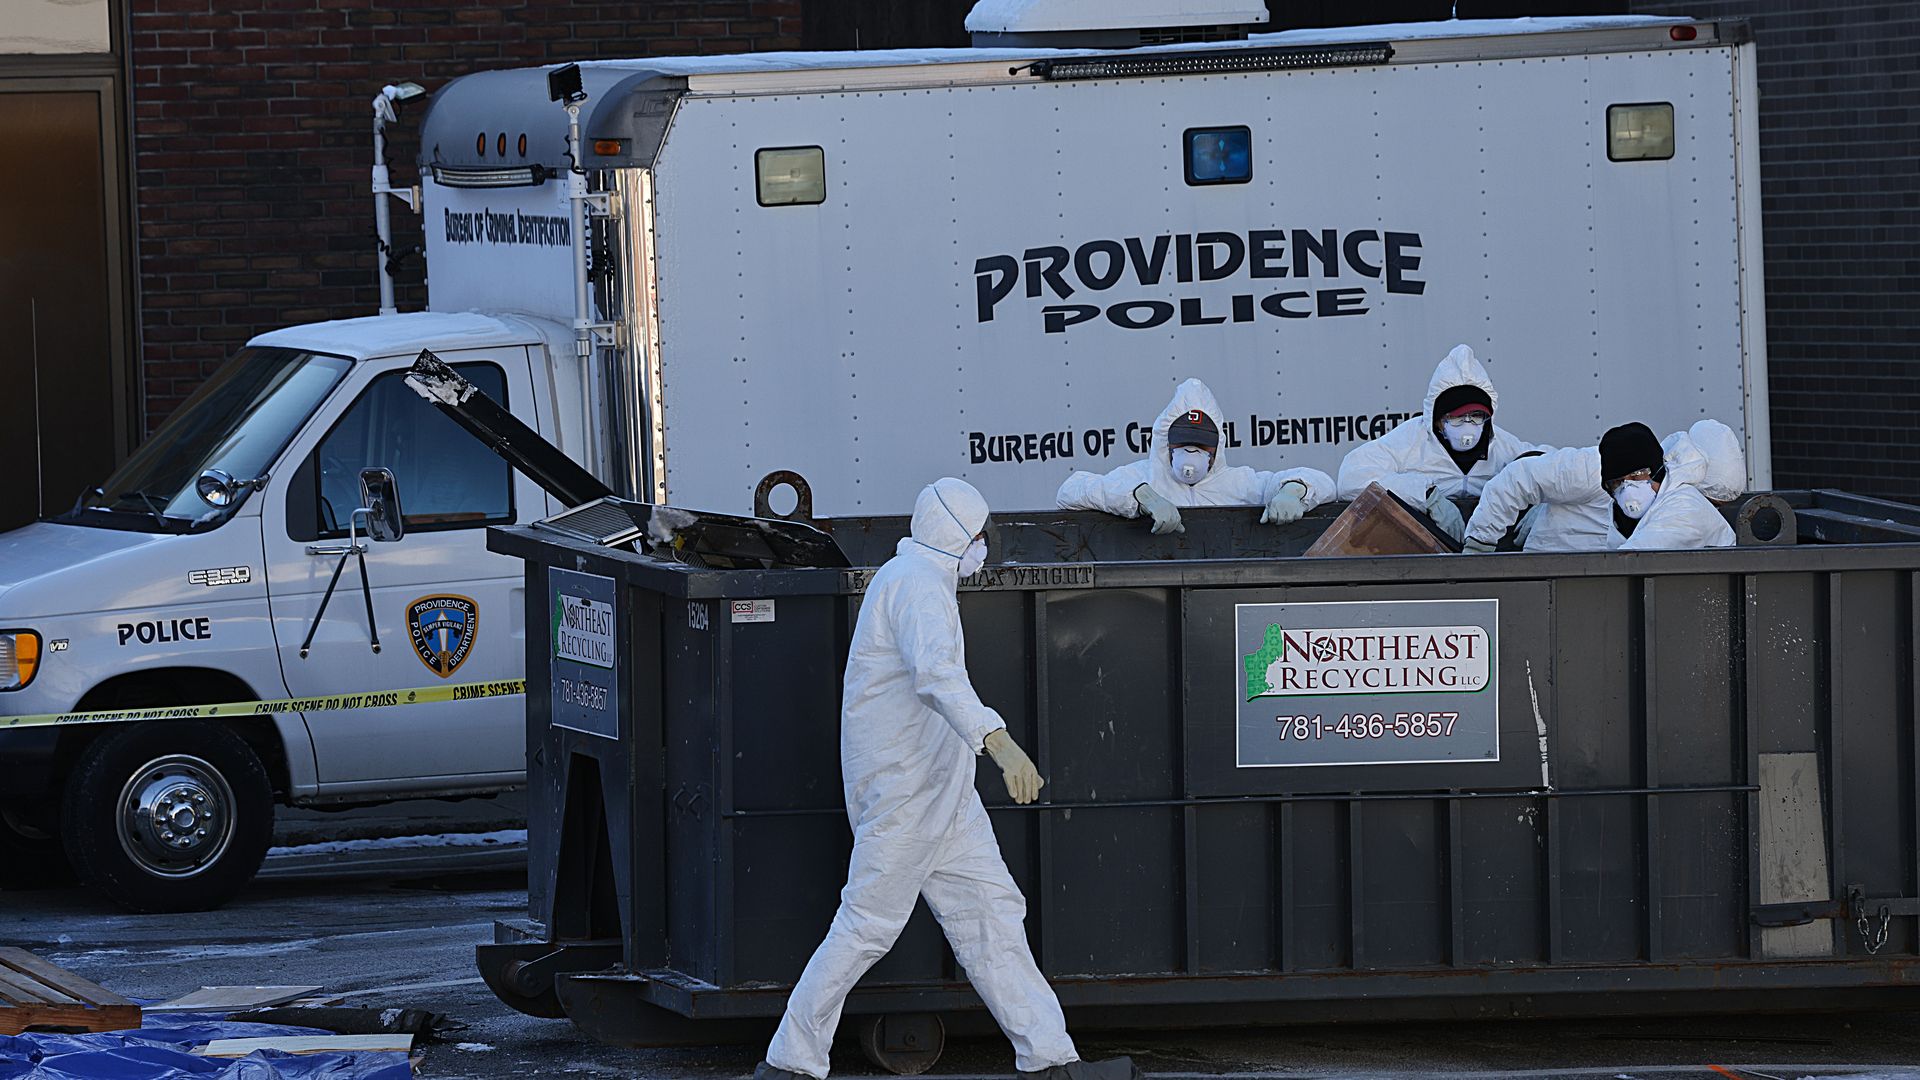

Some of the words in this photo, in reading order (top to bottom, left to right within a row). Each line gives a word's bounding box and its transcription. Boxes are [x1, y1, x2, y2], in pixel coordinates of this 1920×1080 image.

[444, 207, 474, 246] BUREAU
[474, 212, 484, 246] OF
[485, 206, 517, 246] CRIMINAL
[517, 208, 572, 248] IDENTIFICATION
[973, 228, 1427, 323] PROVIDENCE
[1041, 287, 1371, 333] POLICE
[969, 431, 1074, 464] BUREAU
[1083, 428, 1116, 458] OF
[1012, 566, 1093, 586] WEIGHT
[414, 599, 471, 614] PROVIDENCE
[560, 597, 612, 637] NORTHEAST
[687, 600, 709, 631] 15264
[734, 603, 752, 611] CCS
[117, 617, 212, 646] POLICE
[410, 621, 438, 665] POLICE
[449, 612, 476, 667] DEPARTMENT
[561, 630, 608, 663] RECYCLING
[50, 642, 68, 653] V10
[1280, 631, 1480, 665] NORTHEAST
[453, 685, 485, 700] CRIME
[487, 681, 520, 697] SCENE
[1280, 666, 1458, 690] RECYCLING
[1461, 676, 1481, 686] LLC
[255, 702, 289, 714] CRIME
[290, 699, 323, 712] SCENE
[323, 698, 340, 711] DO
[341, 696, 362, 709] NOT
[363, 692, 398, 708] CROSS
[561, 679, 608, 711] 781-436-5857
[1276, 712, 1459, 741] 781-436-5857
